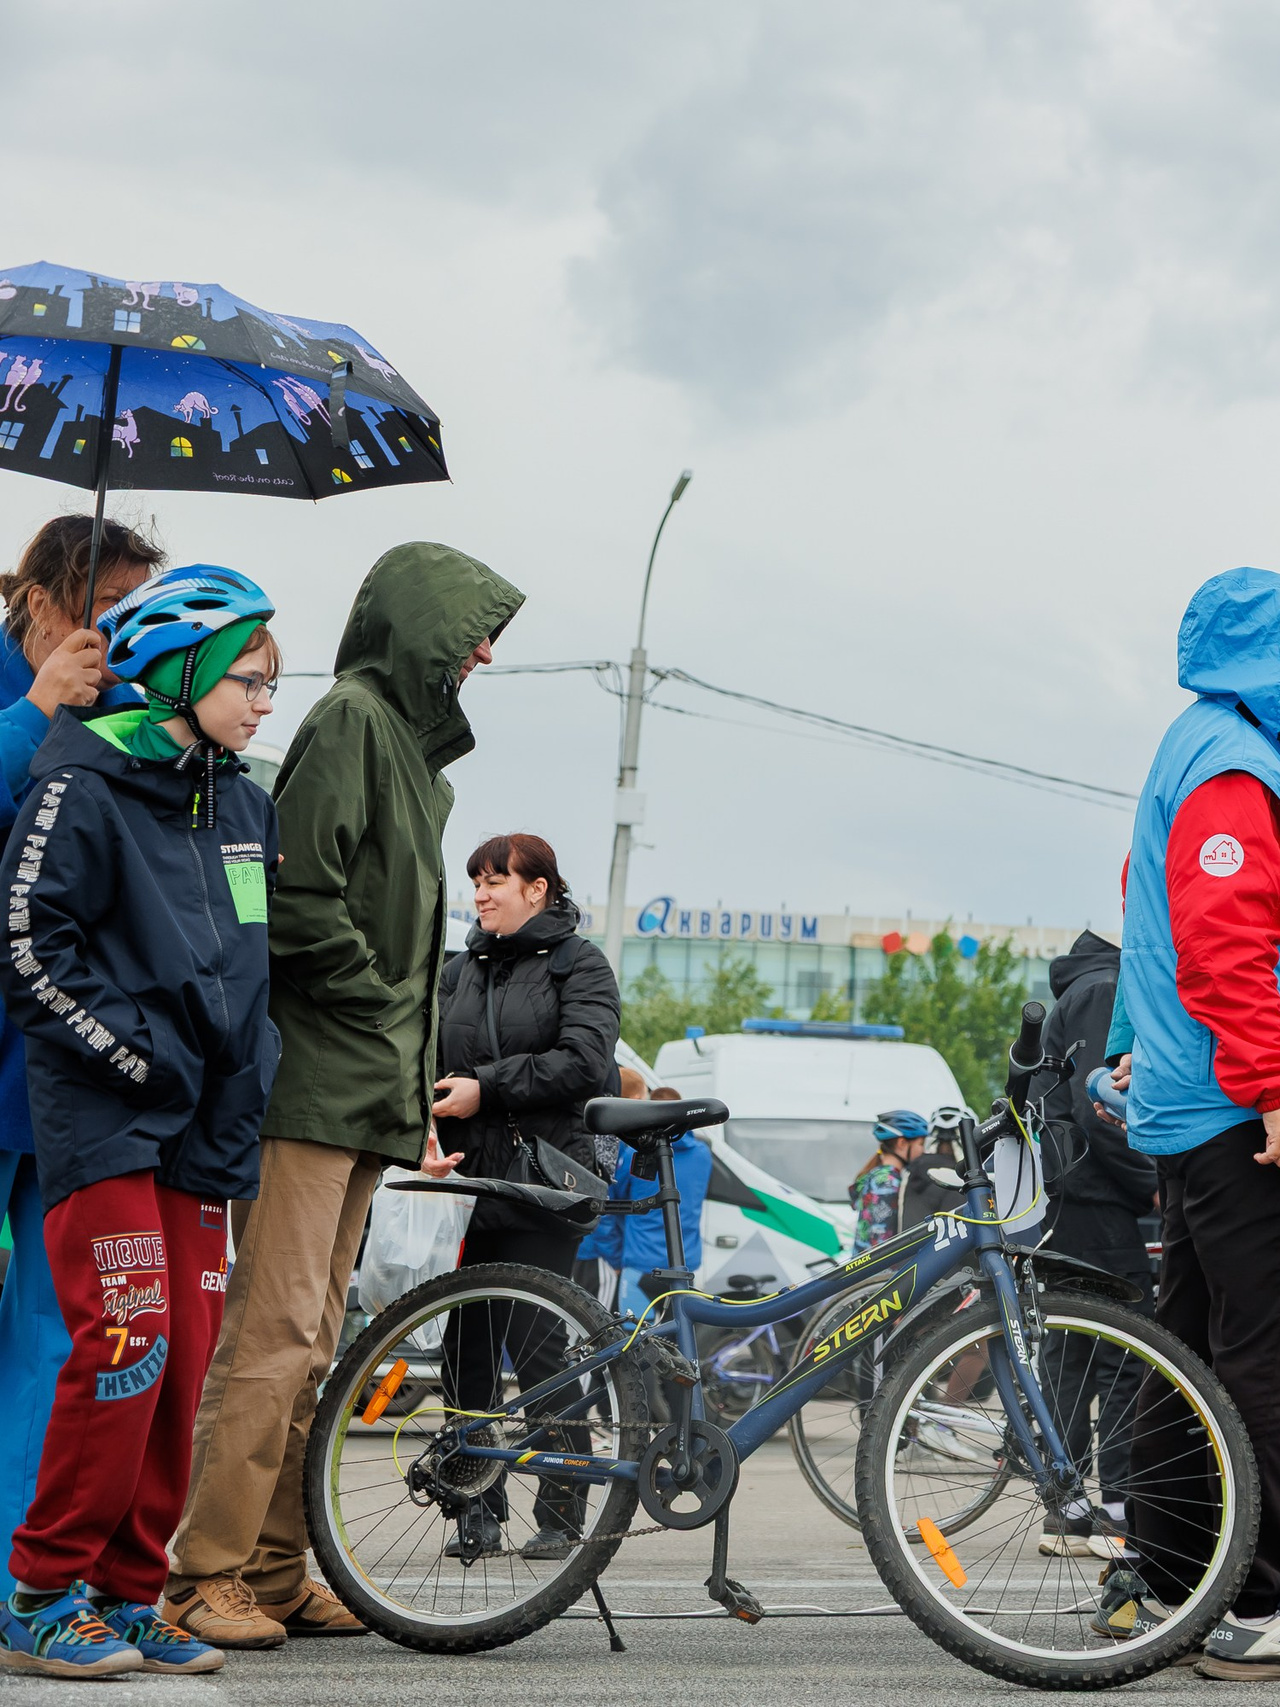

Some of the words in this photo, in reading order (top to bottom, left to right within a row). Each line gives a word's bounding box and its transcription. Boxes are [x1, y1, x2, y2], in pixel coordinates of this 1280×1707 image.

[16, 834, 48, 883] PATH
[8, 883, 32, 932] PATH
[31, 973, 77, 1016] PATH
[66, 1008, 116, 1052] PATH
[981, 1120, 1001, 1135] STERN
[927, 1209, 968, 1252] 24
[100, 1275, 127, 1288] TEAM
[845, 1254, 871, 1272] ATTACK
[105, 1326, 129, 1366] 7
[129, 1336, 149, 1347] EST.
[813, 1289, 903, 1363] STERN
[1009, 1319, 1029, 1365] STERN
[543, 1456, 564, 1465] JUNIOR
[563, 1458, 590, 1467] CONCEPT
